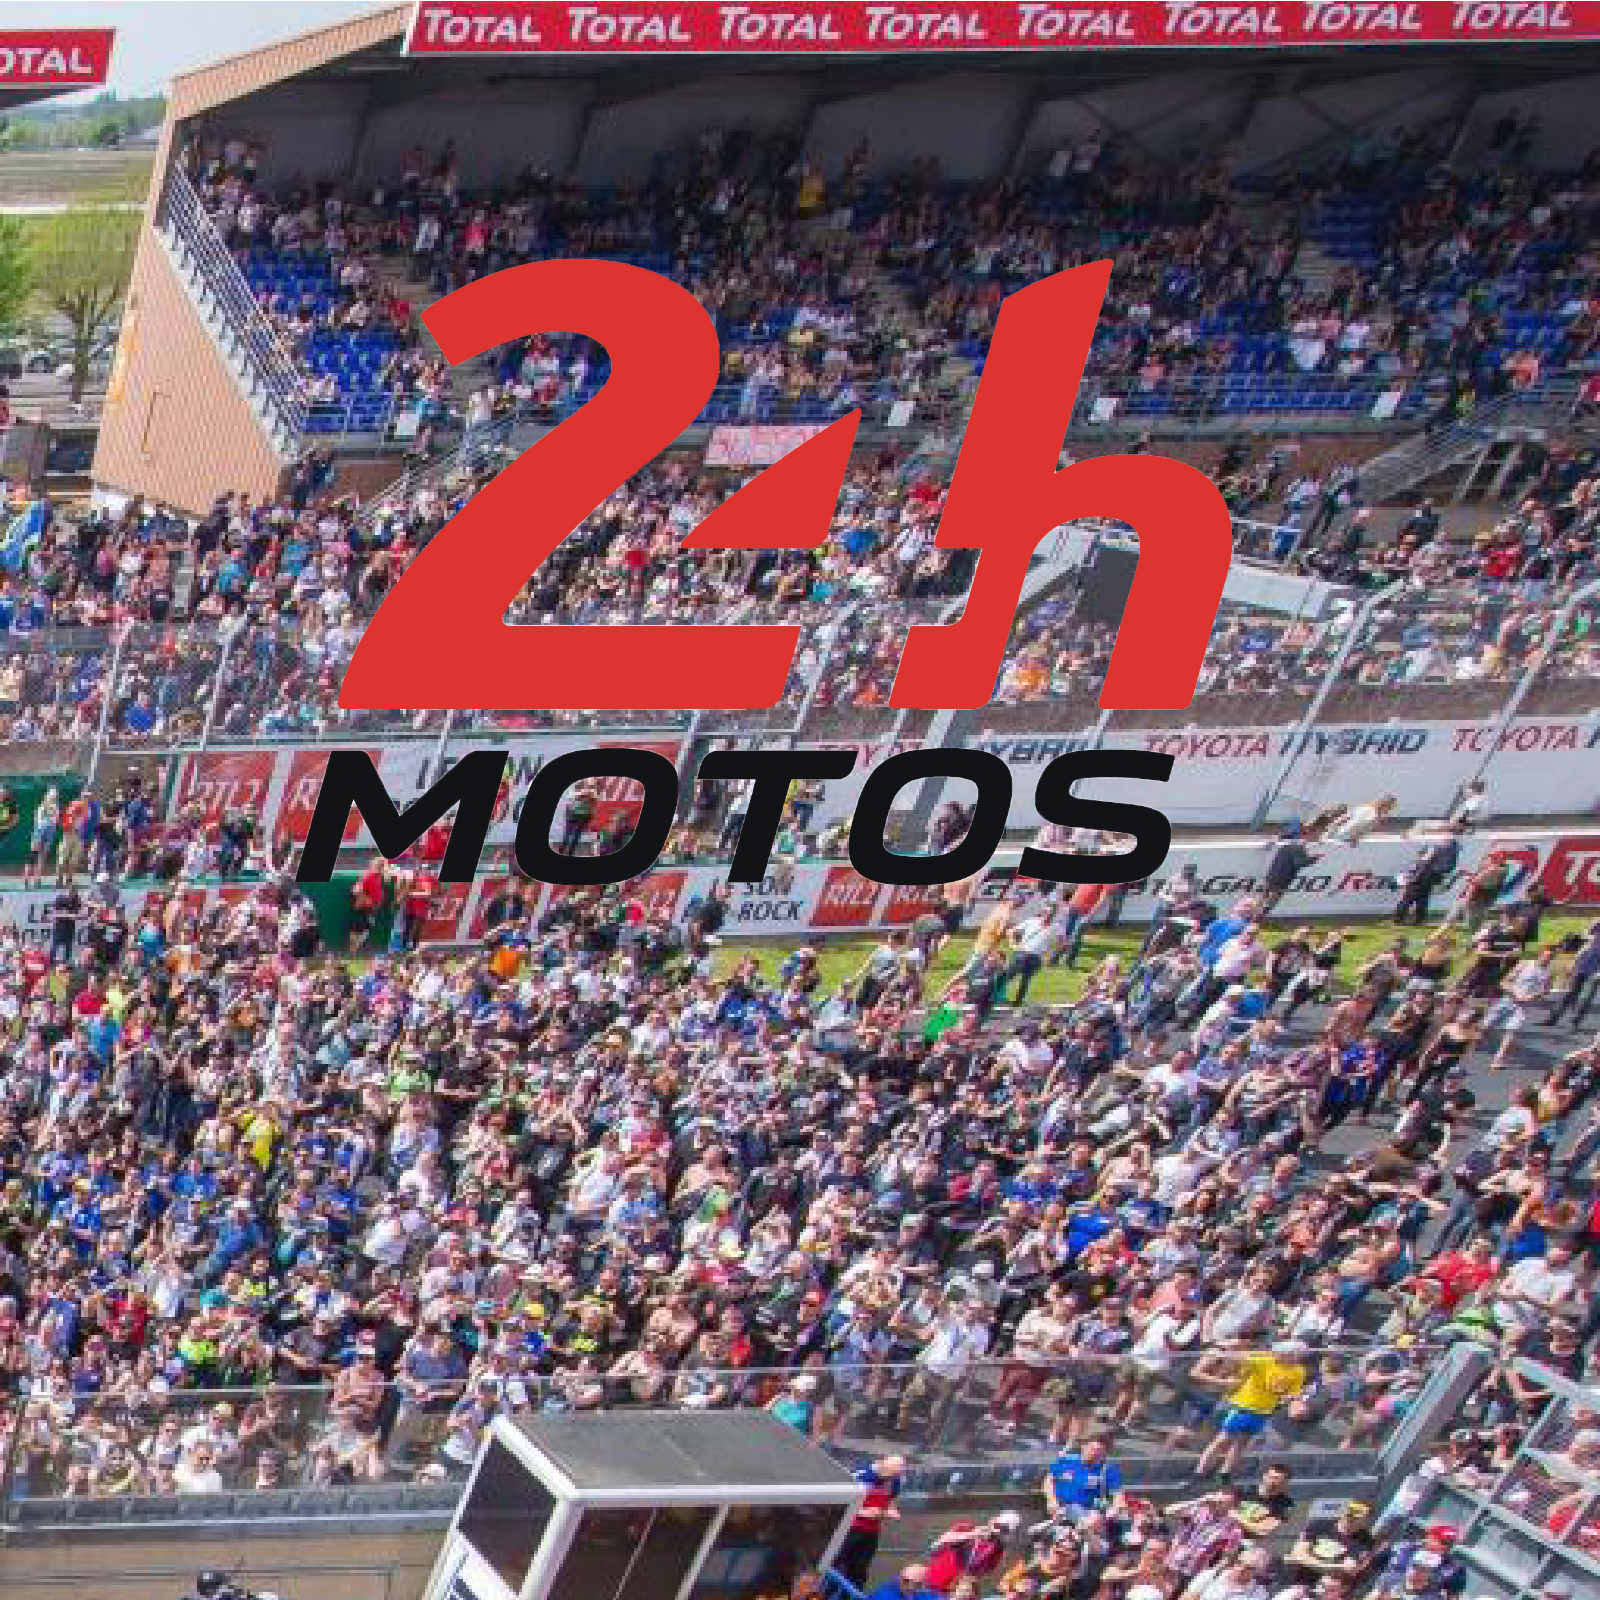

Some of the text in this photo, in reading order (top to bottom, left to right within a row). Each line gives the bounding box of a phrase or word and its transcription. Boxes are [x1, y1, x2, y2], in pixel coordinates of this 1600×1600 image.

[423, 0, 1572, 43] TOTAL TOTAL TOTAL TOTAL TOTAL TOTAL TOTAL TOTAL
